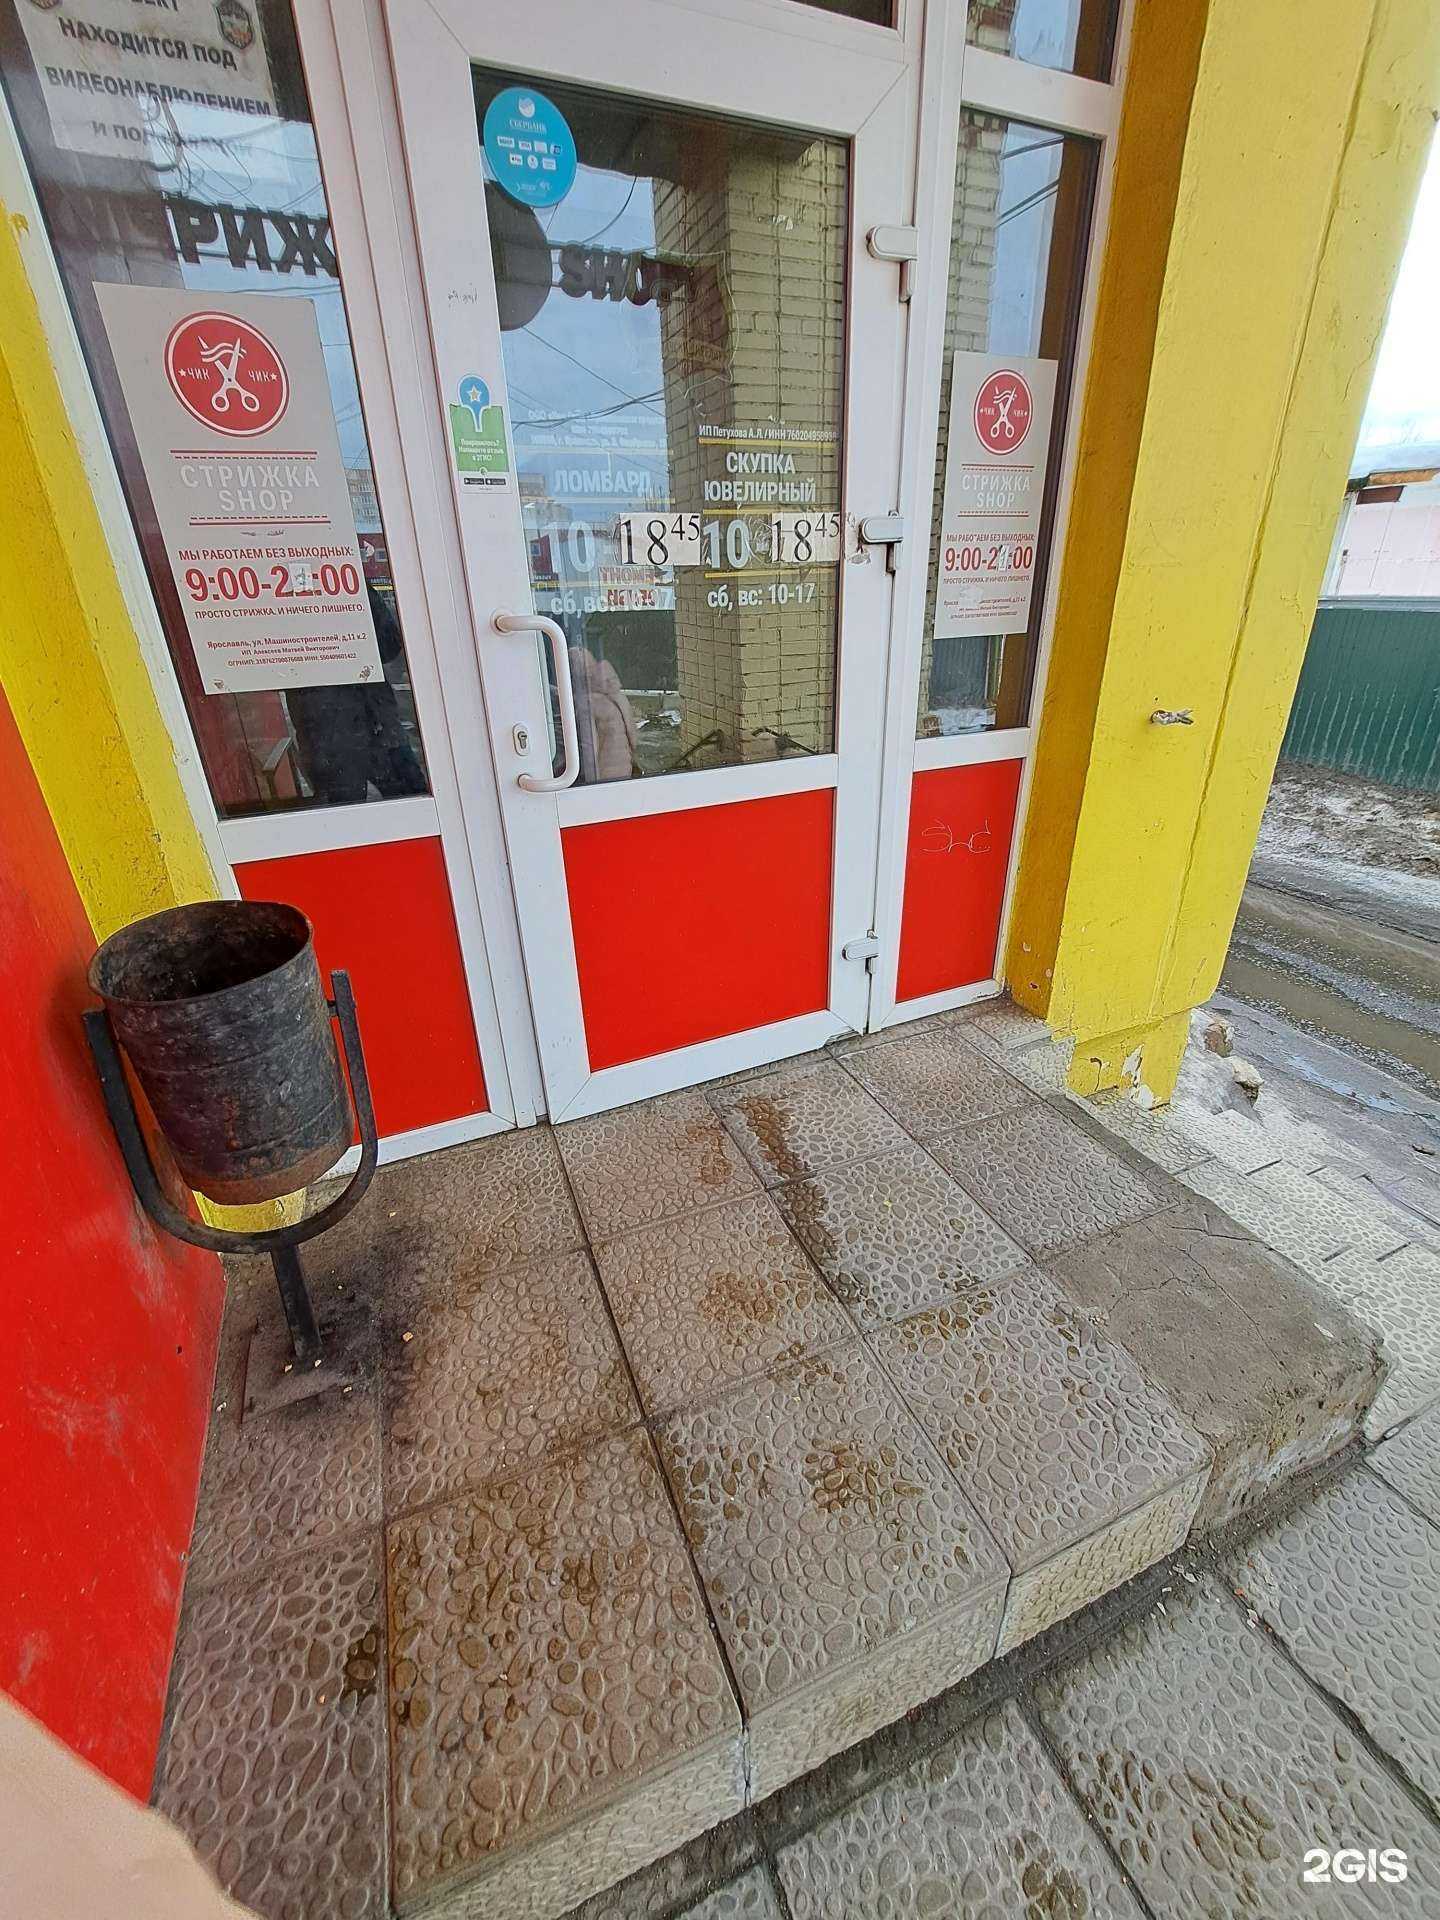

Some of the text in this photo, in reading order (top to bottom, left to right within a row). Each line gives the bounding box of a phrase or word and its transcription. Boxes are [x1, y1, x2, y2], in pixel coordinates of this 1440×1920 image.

[57, 16, 239, 71] НАХОДИТСЯ ПОД
[45, 65, 271, 116] ВИДЕОНАБЛЮДЕНИЕМ
[187, 368, 210, 381] ЧИК
[248, 370, 271, 383] ЧИК
[699, 425, 712, 436] ИП
[713, 426, 747, 439] Петухова
[768, 430, 786, 439] ИНН
[726, 452, 796, 475] СКУПКА
[180, 465, 320, 488] СТРИЖКА
[553, 469, 651, 493] ЛОМБАРД
[962, 474, 1031, 491] СТРИЖКА
[218, 490, 294, 512] SHOP
[704, 478, 816, 503] ЮВЕЛИРНЫЙ
[976, 492, 1015, 508] SHOP
[703, 520, 750, 569] 10
[946, 534, 958, 542] МЫ
[959, 534, 989, 542] РАБОТАЕМ
[990, 533, 1000, 542] БЕЗ
[178, 546, 355, 561] МЫ РАБОТАЕМ БЕЗ ВЫХОДНЫХ:
[550, 590, 582, 619] сб,
[707, 583, 816, 611] сб, вс: 10-17
[195, 609, 231, 620] ПРОСТО
[277, 606, 285, 615] И
[286, 605, 320, 615] НИЧЕГО
[321, 603, 365, 613] ЛИШНЕГО.
[207, 640, 251, 650] Ярославль,
[253, 639, 264, 648] ул.
